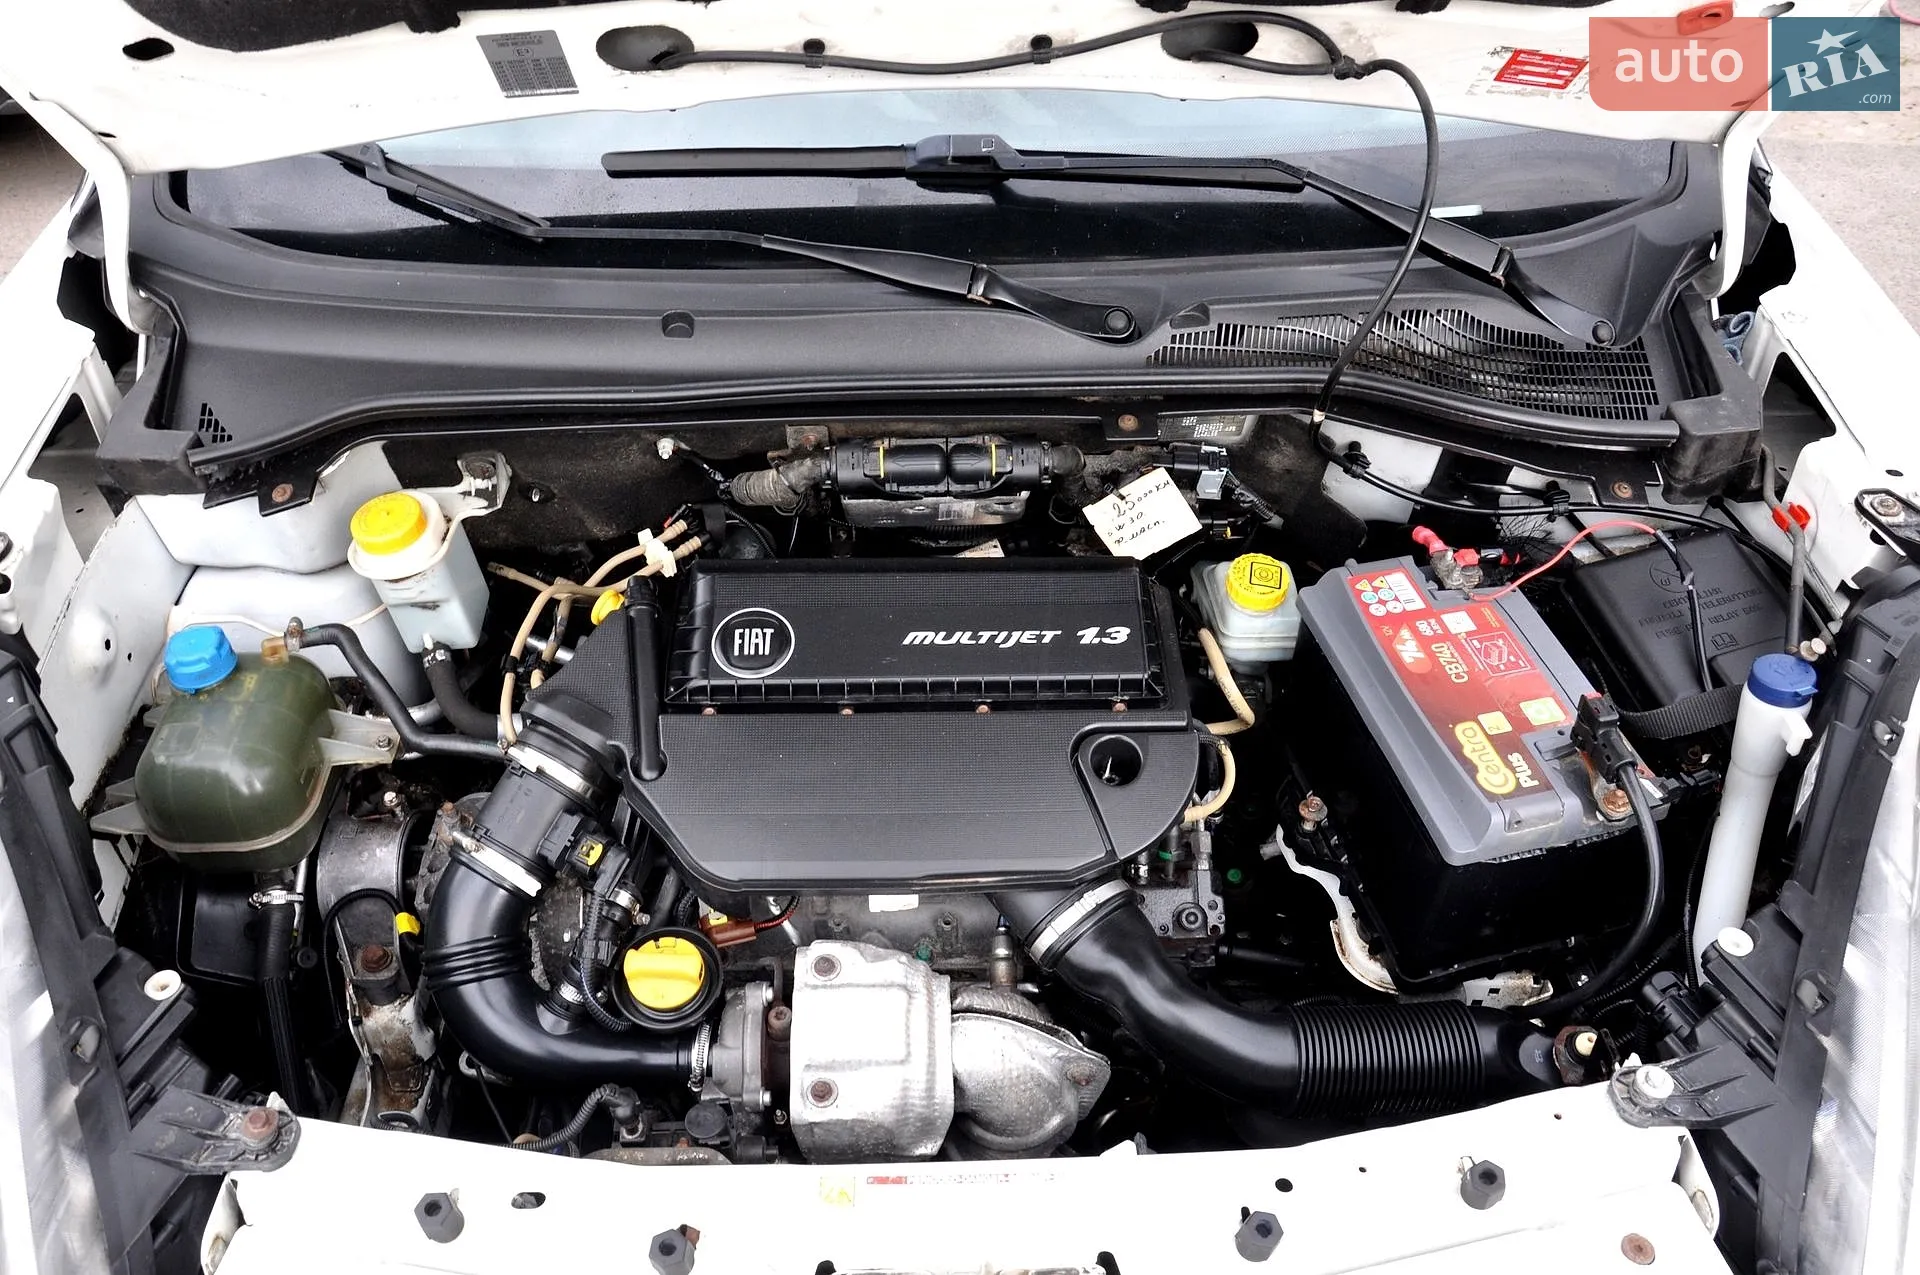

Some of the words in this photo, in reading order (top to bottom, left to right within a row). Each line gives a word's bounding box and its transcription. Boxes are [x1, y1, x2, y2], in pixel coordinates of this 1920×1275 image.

[733, 628, 775, 656] FIAT
[902, 630, 1063, 648] MULTIJET
[1076, 626, 1132, 645] 1.3
[1431, 642, 1469, 684] CB740
[1461, 725, 1509, 788] Centra
[1507, 752, 1540, 788] Plus
